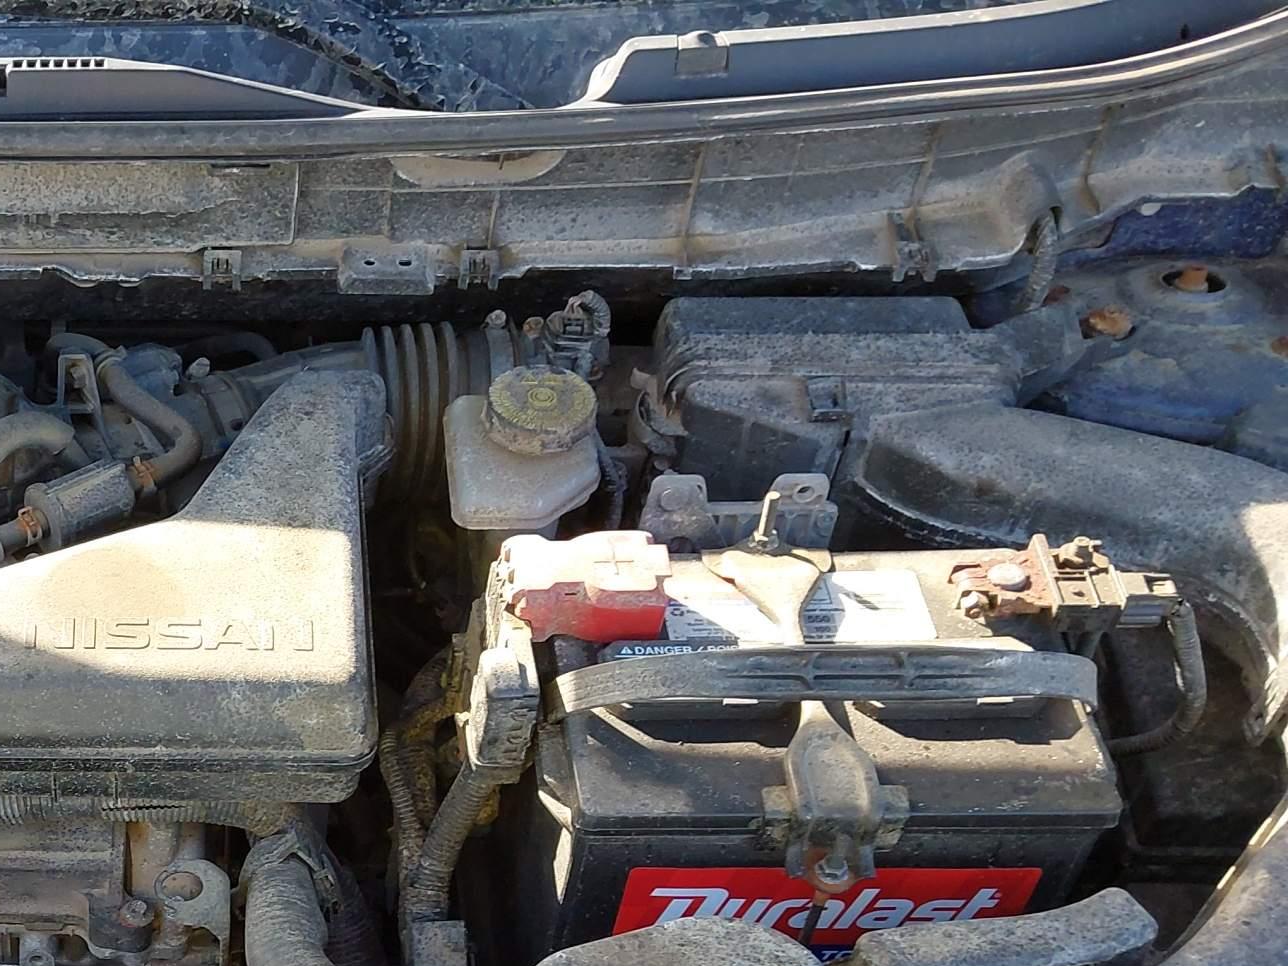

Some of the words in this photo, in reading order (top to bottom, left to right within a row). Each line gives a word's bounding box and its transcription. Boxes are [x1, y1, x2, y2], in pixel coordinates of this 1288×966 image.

[23, 616, 314, 651] NISSAN
[634, 645, 692, 655] DANGER
[649, 888, 1001, 929] Duralast
